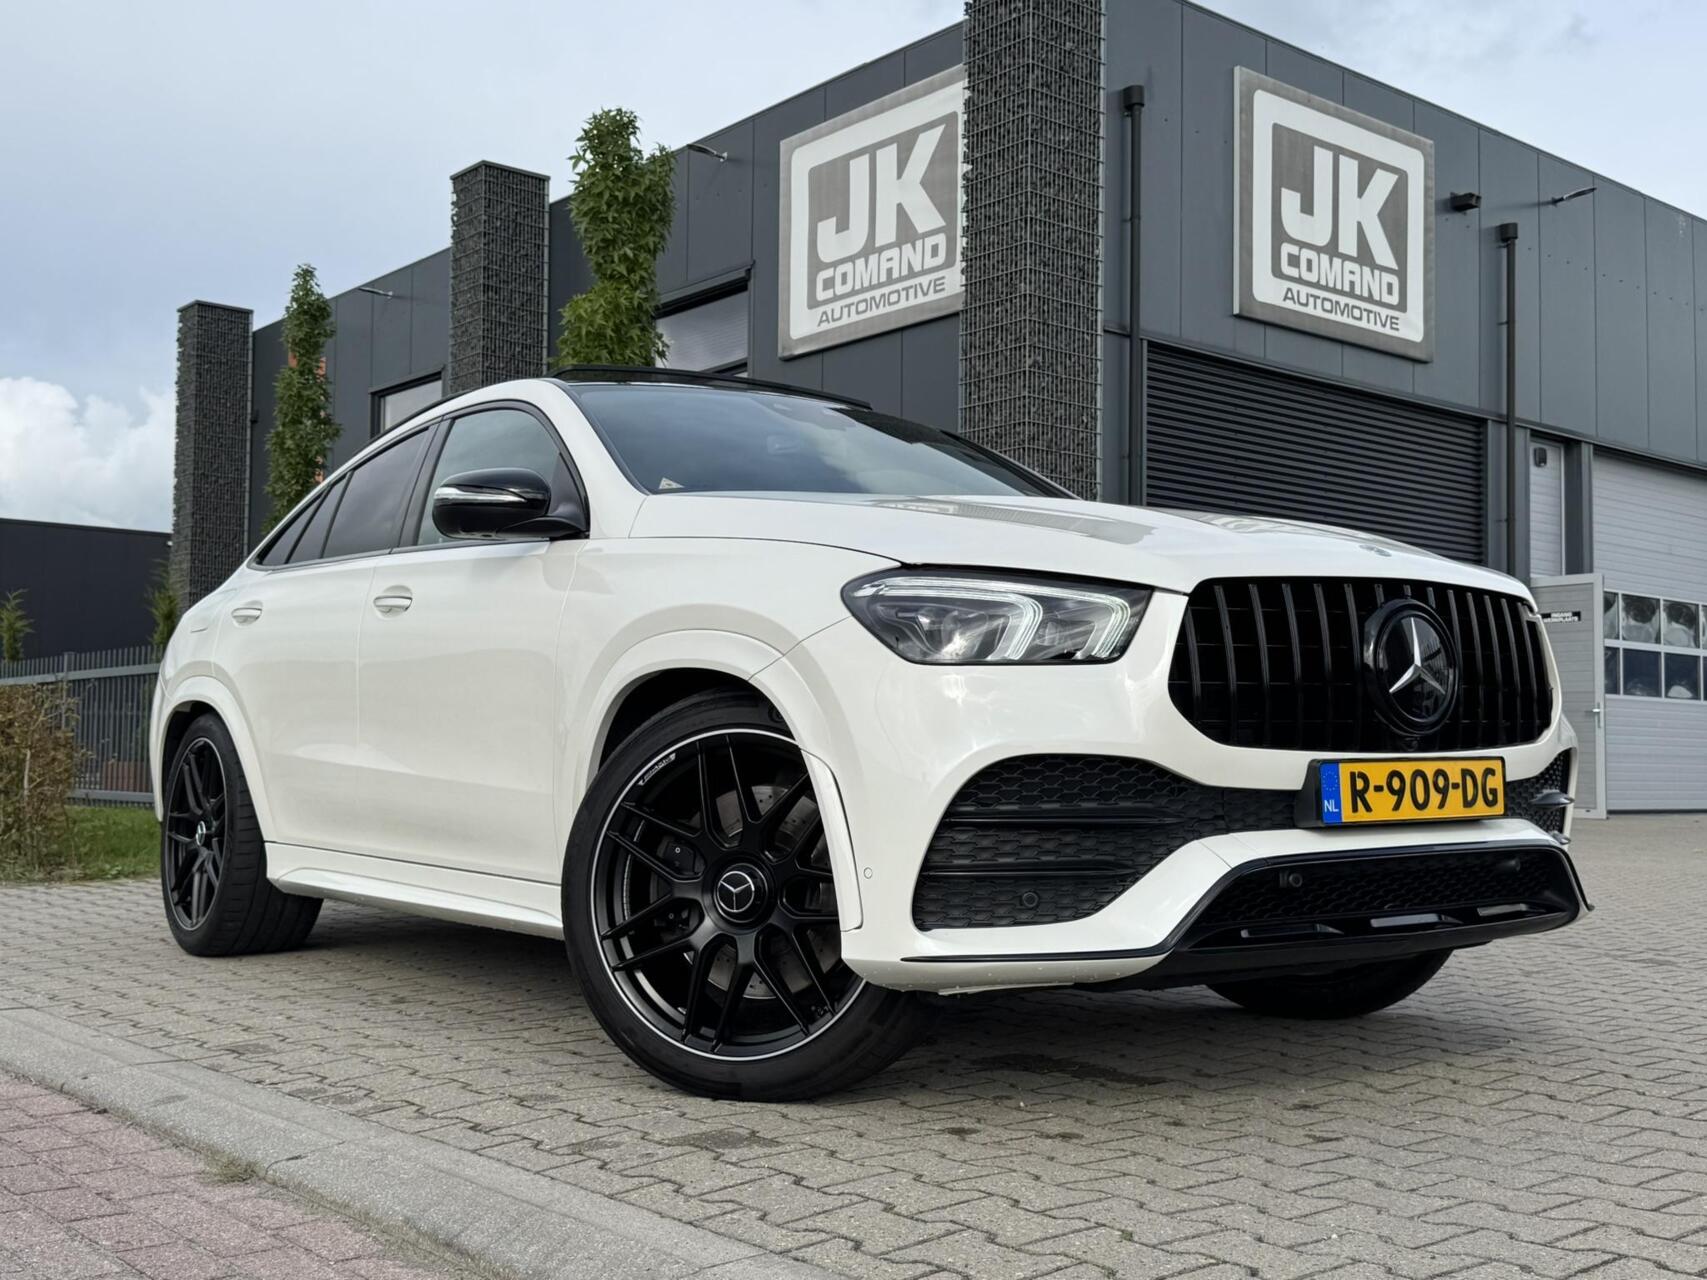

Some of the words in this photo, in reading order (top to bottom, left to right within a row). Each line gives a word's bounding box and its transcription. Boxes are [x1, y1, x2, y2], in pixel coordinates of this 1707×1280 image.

[817, 124, 947, 263] JK
[1280, 145, 1399, 270] JK
[816, 232, 947, 302] COMAND
[1280, 242, 1399, 306] COMAND
[817, 275, 946, 327] AUTOMOTIVE
[1283, 287, 1400, 331] AUTOMOTIVE
[1324, 799, 1339, 813] NL
[1350, 767, 1499, 813] R-909-DG
